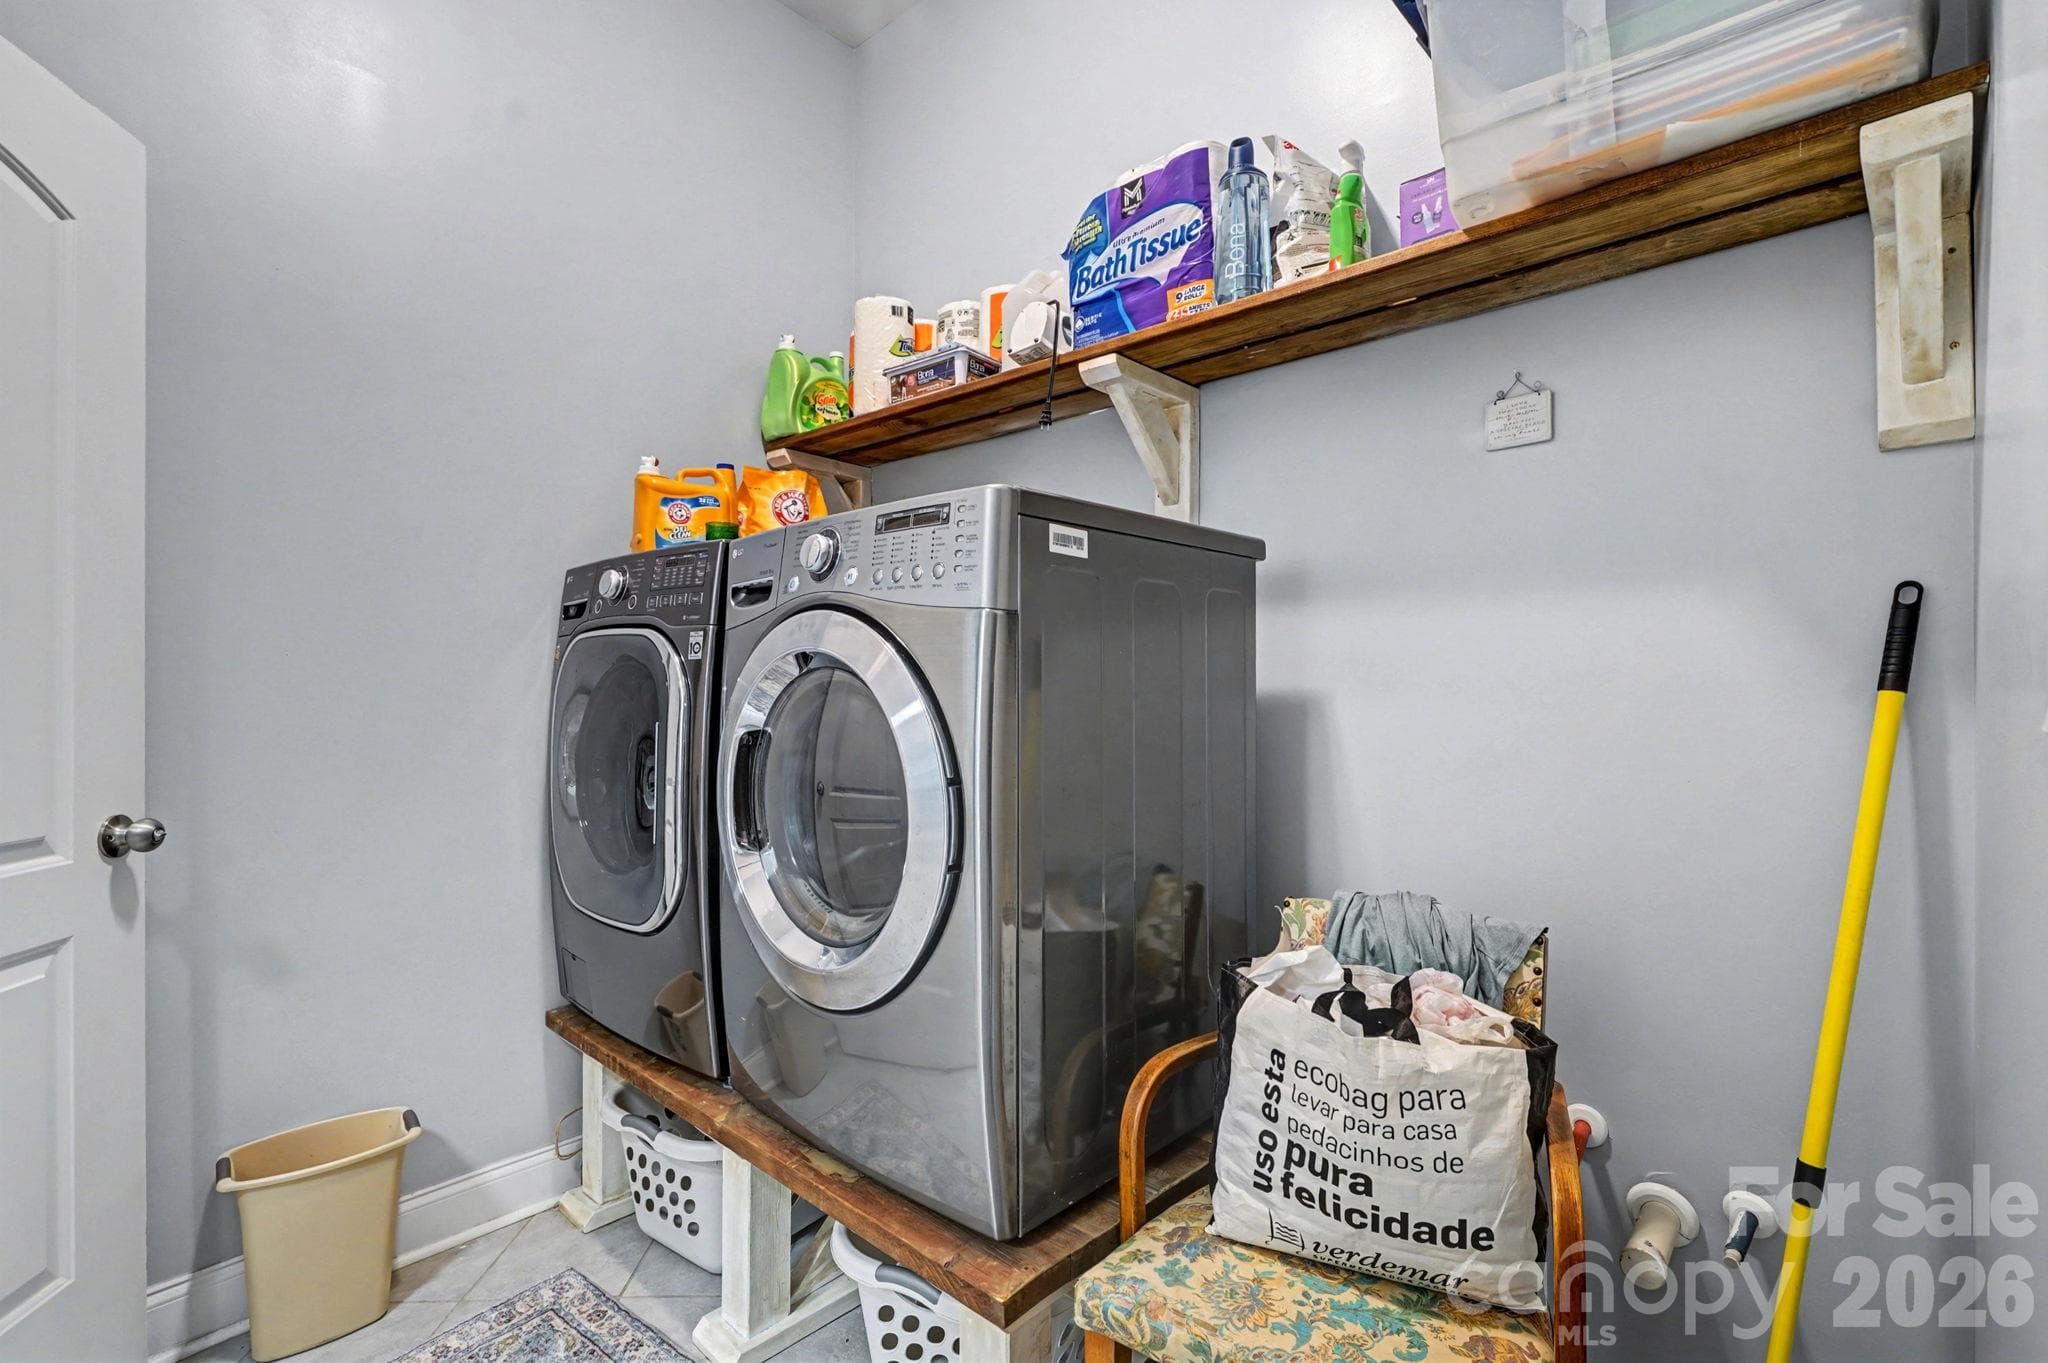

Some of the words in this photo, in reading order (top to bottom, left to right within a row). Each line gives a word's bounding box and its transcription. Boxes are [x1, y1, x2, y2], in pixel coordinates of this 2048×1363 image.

[1076, 247, 1127, 299] Bath
[1127, 218, 1202, 274] Tissue
[1225, 223, 1246, 280] Bona
[969, 358, 986, 373] Bona
[1261, 1048, 1286, 1124] esta
[1291, 1082, 1339, 1121] levar
[1343, 1111, 1396, 1141] para
[1403, 1121, 1458, 1141] casa
[1293, 1058, 1389, 1119] ecobag
[1399, 1088, 1467, 1118] para
[1252, 1130, 1278, 1194] uso
[1283, 1140, 1374, 1199] pura
[1287, 1112, 1425, 1174] pedacinhos
[1433, 1150, 1464, 1174] de
[1280, 1172, 1496, 1252] felicidade
[1312, 1240, 1470, 1290] verdemar
